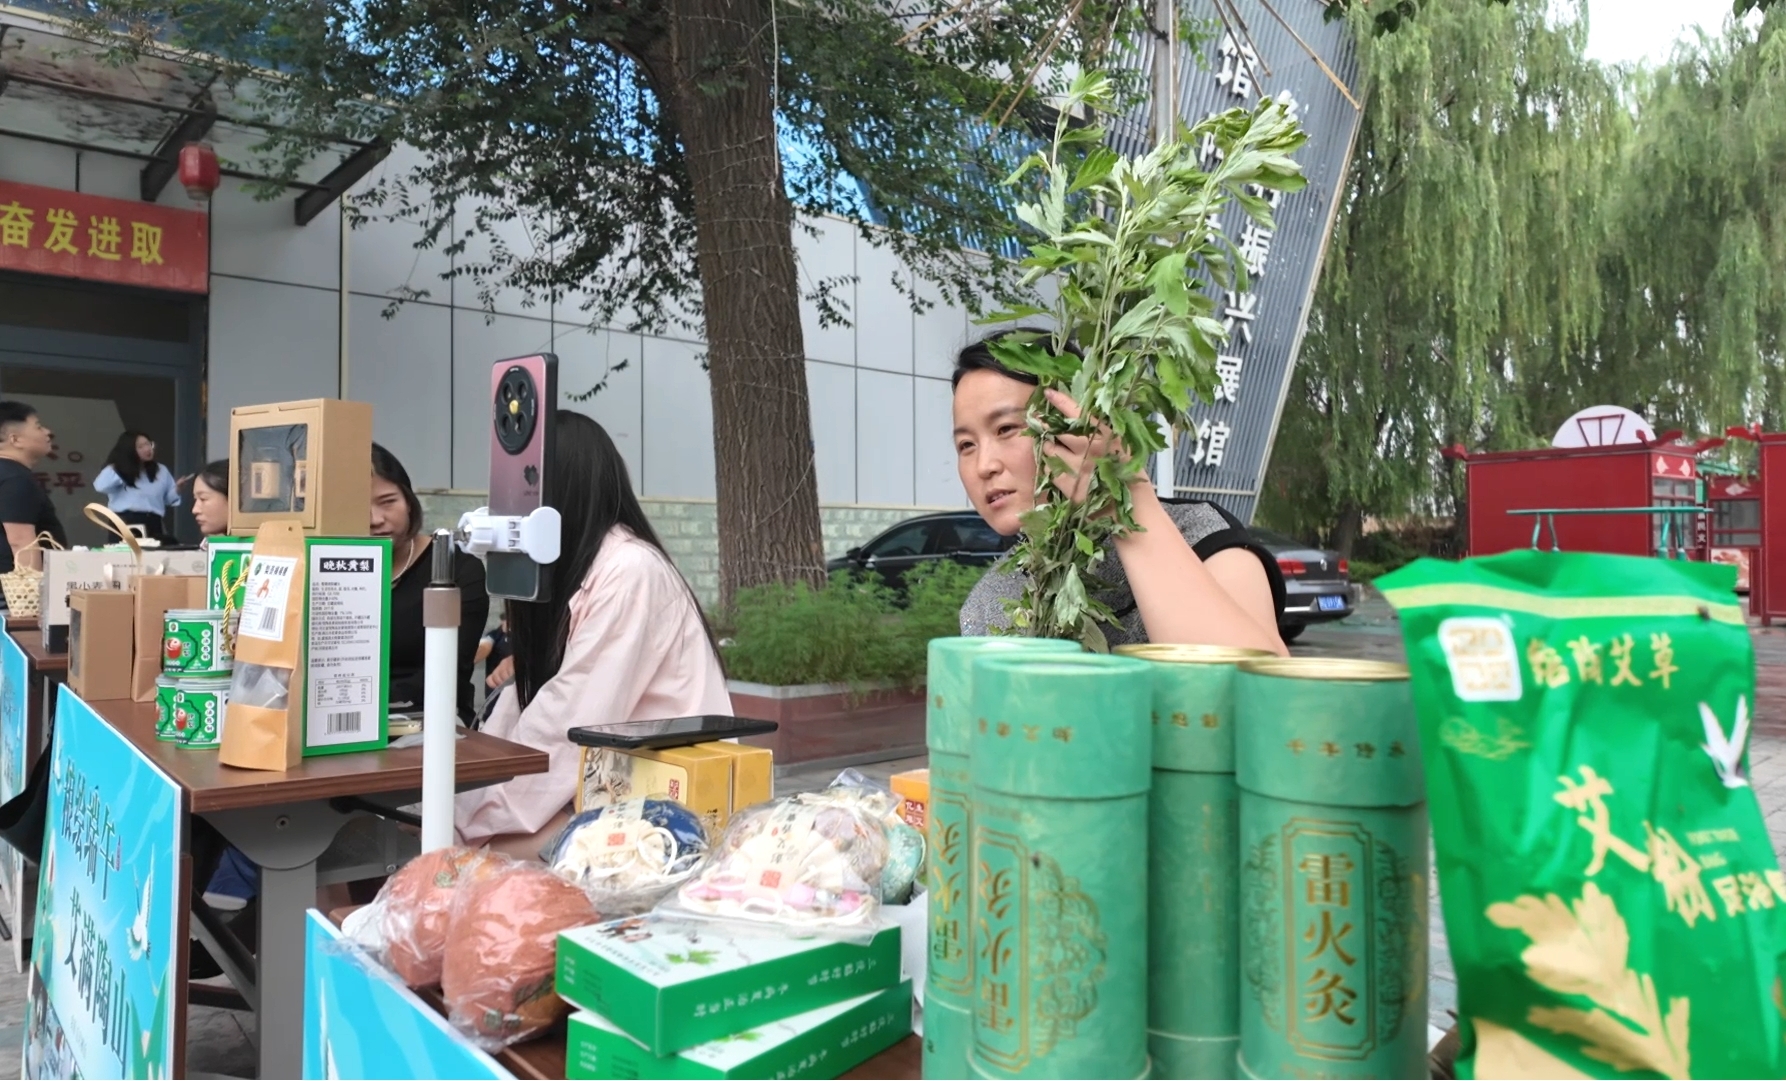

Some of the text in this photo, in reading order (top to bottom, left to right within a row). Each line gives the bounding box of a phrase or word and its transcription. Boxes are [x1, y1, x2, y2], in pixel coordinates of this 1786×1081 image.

[0, 201, 164, 265] 奋发进取
[323, 560, 370, 572] 晚秋黄梨
[64, 886, 130, 1080] 艾满陶山
[978, 861, 1014, 1034] 雷火灸
[1299, 853, 1357, 1026] 雷火灸
